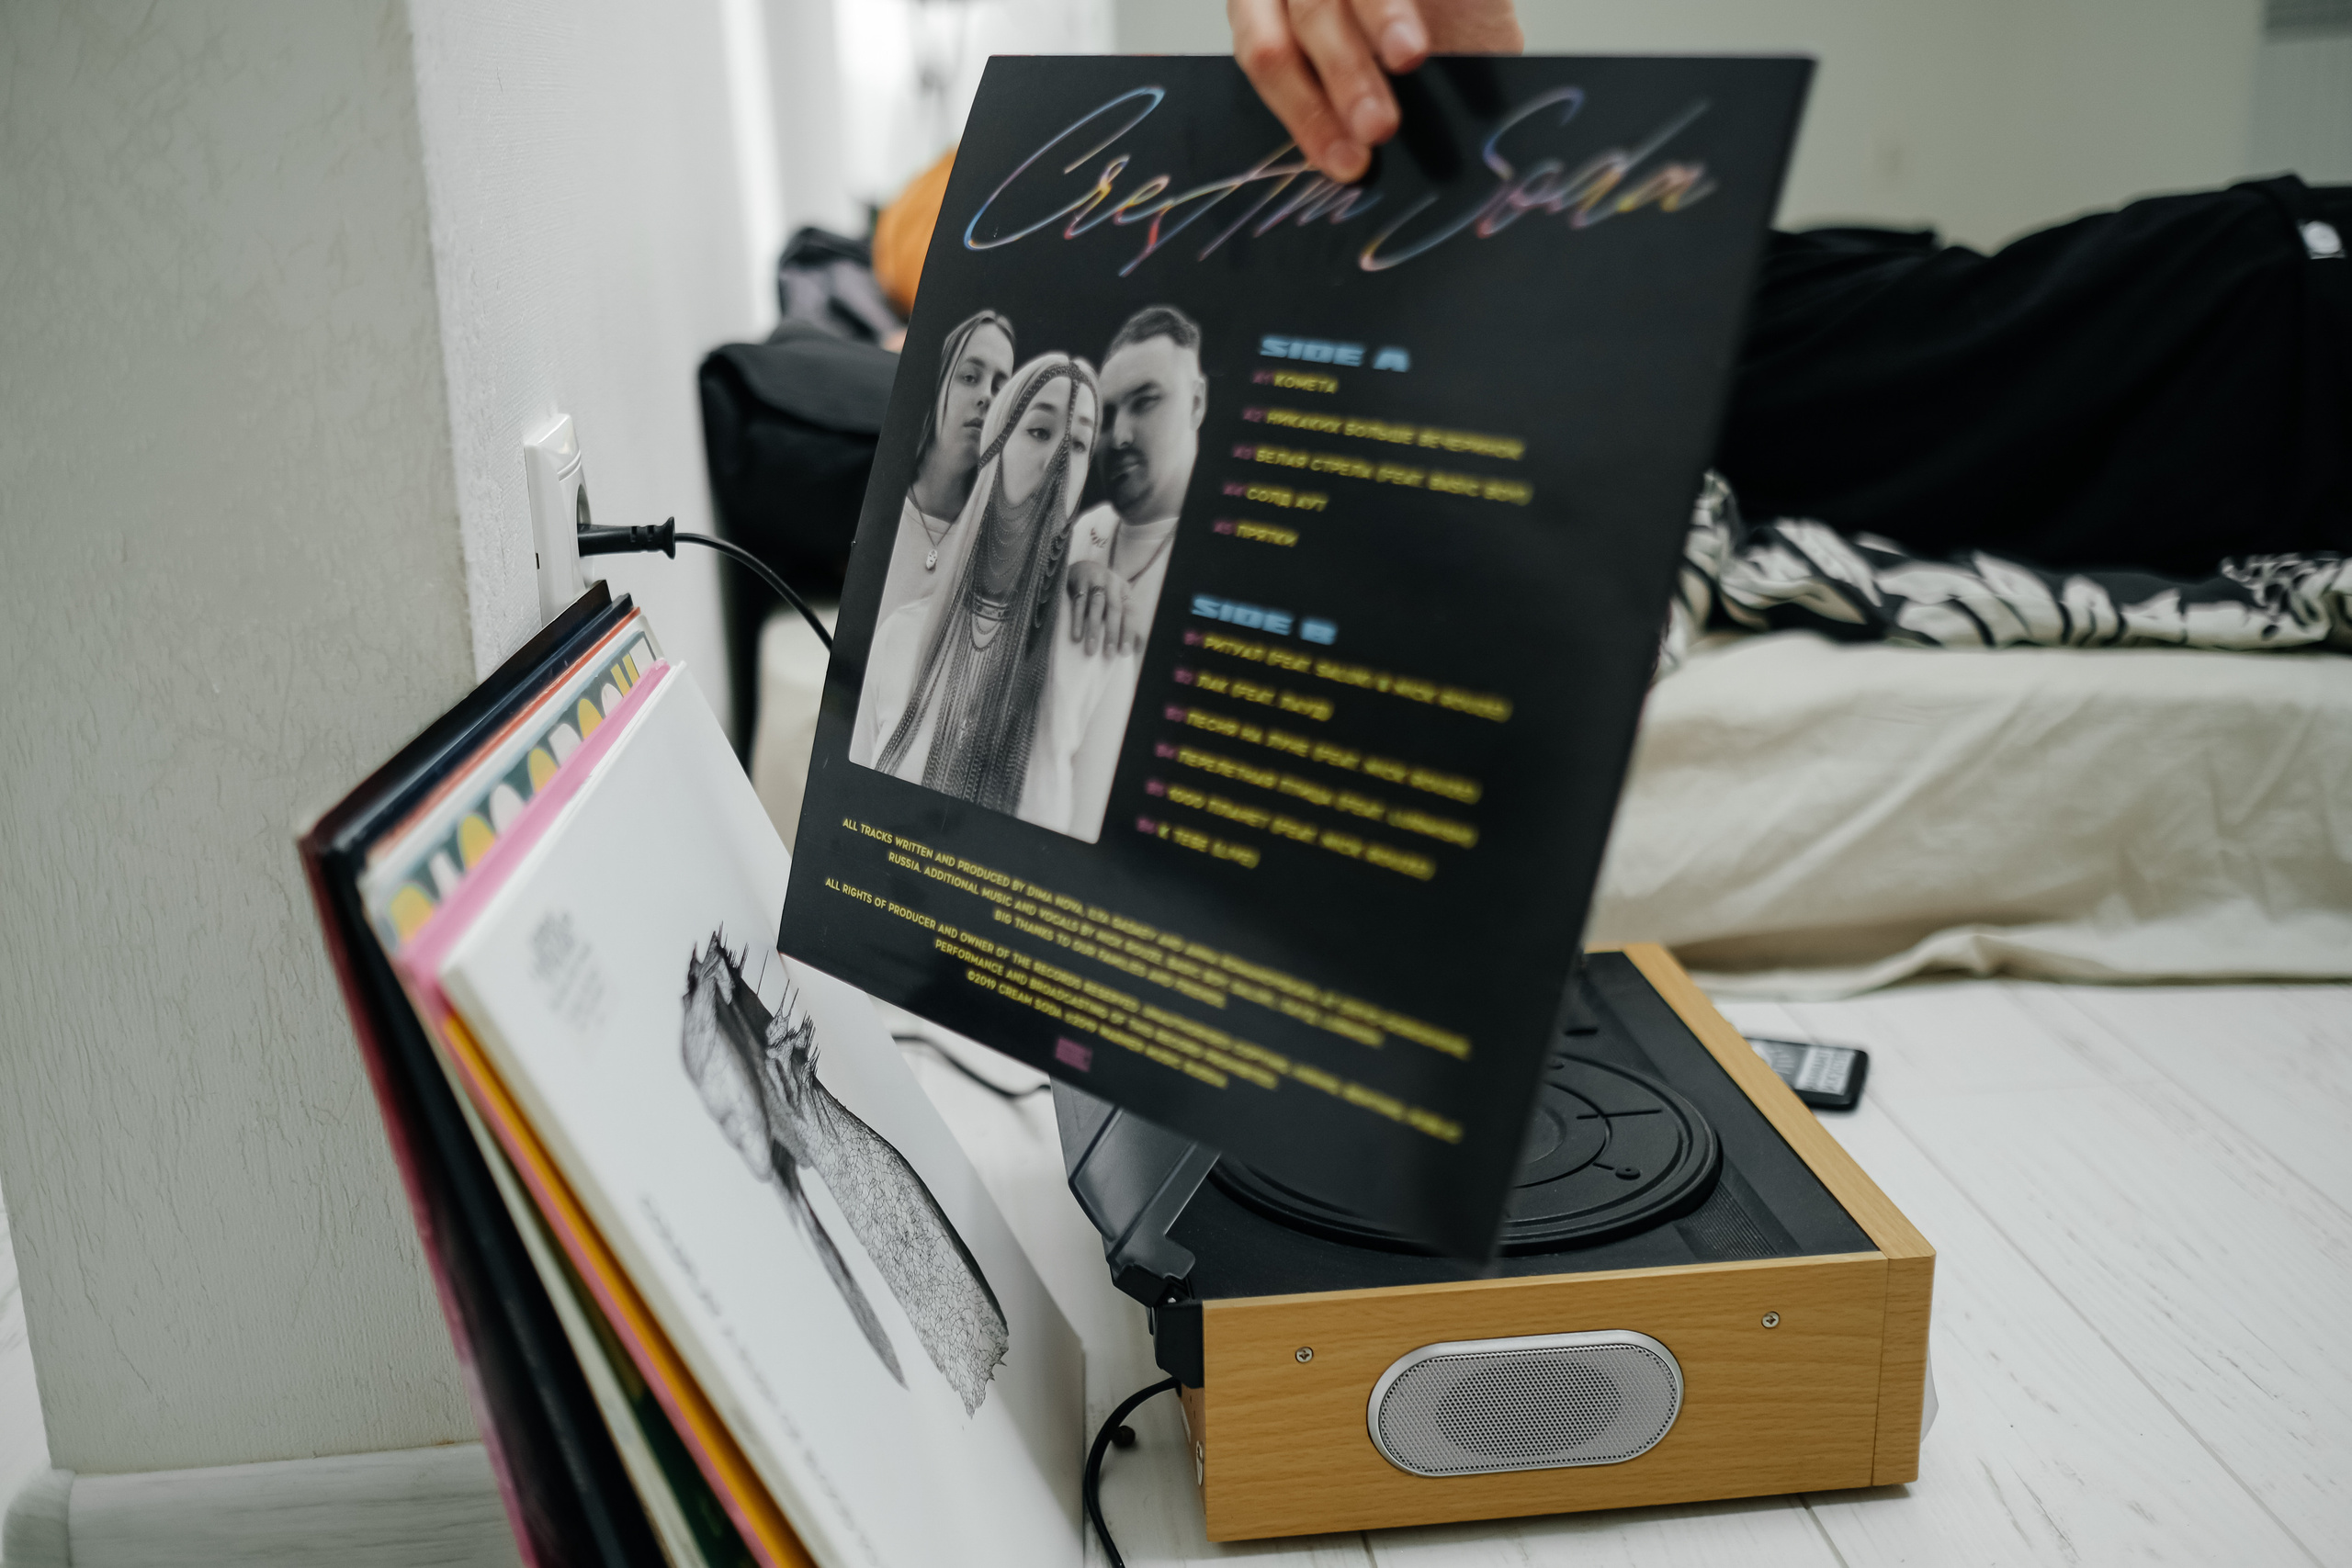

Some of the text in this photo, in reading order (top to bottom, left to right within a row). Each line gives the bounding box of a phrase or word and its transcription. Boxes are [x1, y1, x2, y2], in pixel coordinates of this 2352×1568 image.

[1360, 85, 1720, 273] Soda
[1260, 335, 1410, 373] SIDE A
[1273, 372, 1339, 394] КОМЕТА
[1191, 595, 1339, 645] SIDE B
[842, 818, 858, 832] ALL
[860, 823, 893, 844] TRACKS
[895, 836, 934, 859] WRITTEN
[934, 852, 956, 867] AND
[957, 859, 1011, 888] PRODUCED
[1011, 878, 1026, 893] BY
[1026, 885, 1053, 904] DIMA
[923, 866, 979, 896] ADDITIONAL
[980, 886, 1012, 908] MUSIC
[1014, 900, 1037, 917] AND
[1039, 908, 1080, 932] VOCALS
[825, 877, 841, 892] ALL
[842, 883, 873, 904] RIGHTS
[874, 896, 888, 909] OF
[888, 902, 936, 931] PRODUCER
[937, 921, 959, 939] AND
[959, 931, 995, 954] OWNER
[995, 944, 1011, 959] OF
[1012, 951, 1033, 970] THE
[994, 908, 1012, 925] BIG
[1013, 917, 1055, 942] THANKS
[935, 938, 1004, 976] PERFORMANCE
[1005, 969, 1028, 985] AND
[997, 983, 1034, 1007] CREAM
